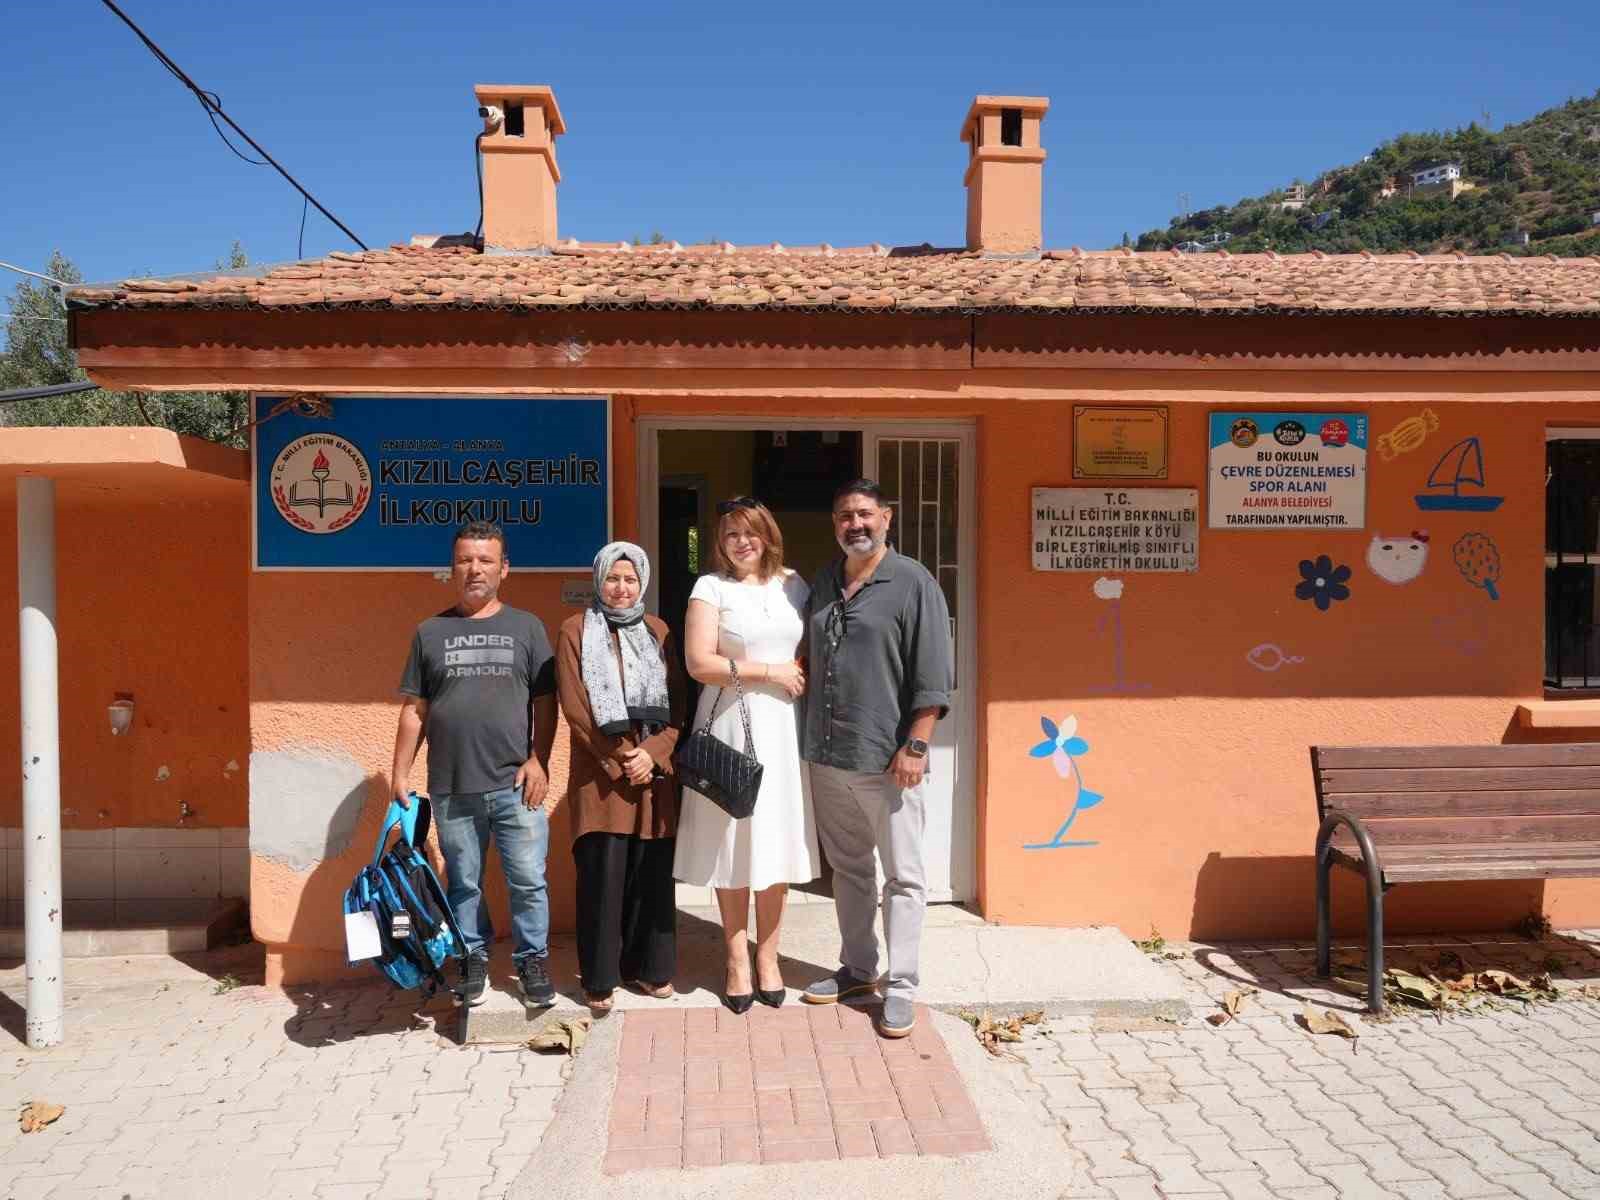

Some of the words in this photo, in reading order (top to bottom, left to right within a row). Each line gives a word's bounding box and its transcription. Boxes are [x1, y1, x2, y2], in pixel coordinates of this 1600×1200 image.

[1257, 452, 1272, 462] BU
[1275, 451, 1319, 462] OKULUN
[379, 452, 601, 489] KIZILCAŞEHİR
[1220, 466, 1262, 480] ÇEVRE
[1265, 464, 1355, 478] DÜZENLEMESİ
[1249, 481, 1284, 493] SPOR
[1287, 481, 1327, 492] ALANI
[1104, 492, 1131, 505] T.C.
[1242, 497, 1279, 508] ALANYA
[1281, 495, 1333, 508] BELEDİYESİ
[379, 493, 542, 525] İLKOKULU
[1036, 506, 1075, 521] MİLLİ
[1079, 507, 1121, 521] EĞİTİM
[1124, 508, 1195, 522] BAKANLIĞI
[1226, 514, 1285, 525] TARAFINDAN
[1286, 514, 1348, 527] YAPILMIŞTIR.
[1050, 523, 1140, 539] KIZILCAŞEHİR
[1145, 523, 1181, 538] KÖYÜ
[1035, 539, 1140, 555] BİRLEŞTİRİLMİŞ
[1145, 542, 1194, 554] SINIFLI
[1050, 554, 1131, 569] İLKÖĞRETİM
[1134, 557, 1179, 569] OKULU
[445, 634, 514, 649] UNDER
[446, 665, 513, 678] ARMOUR
